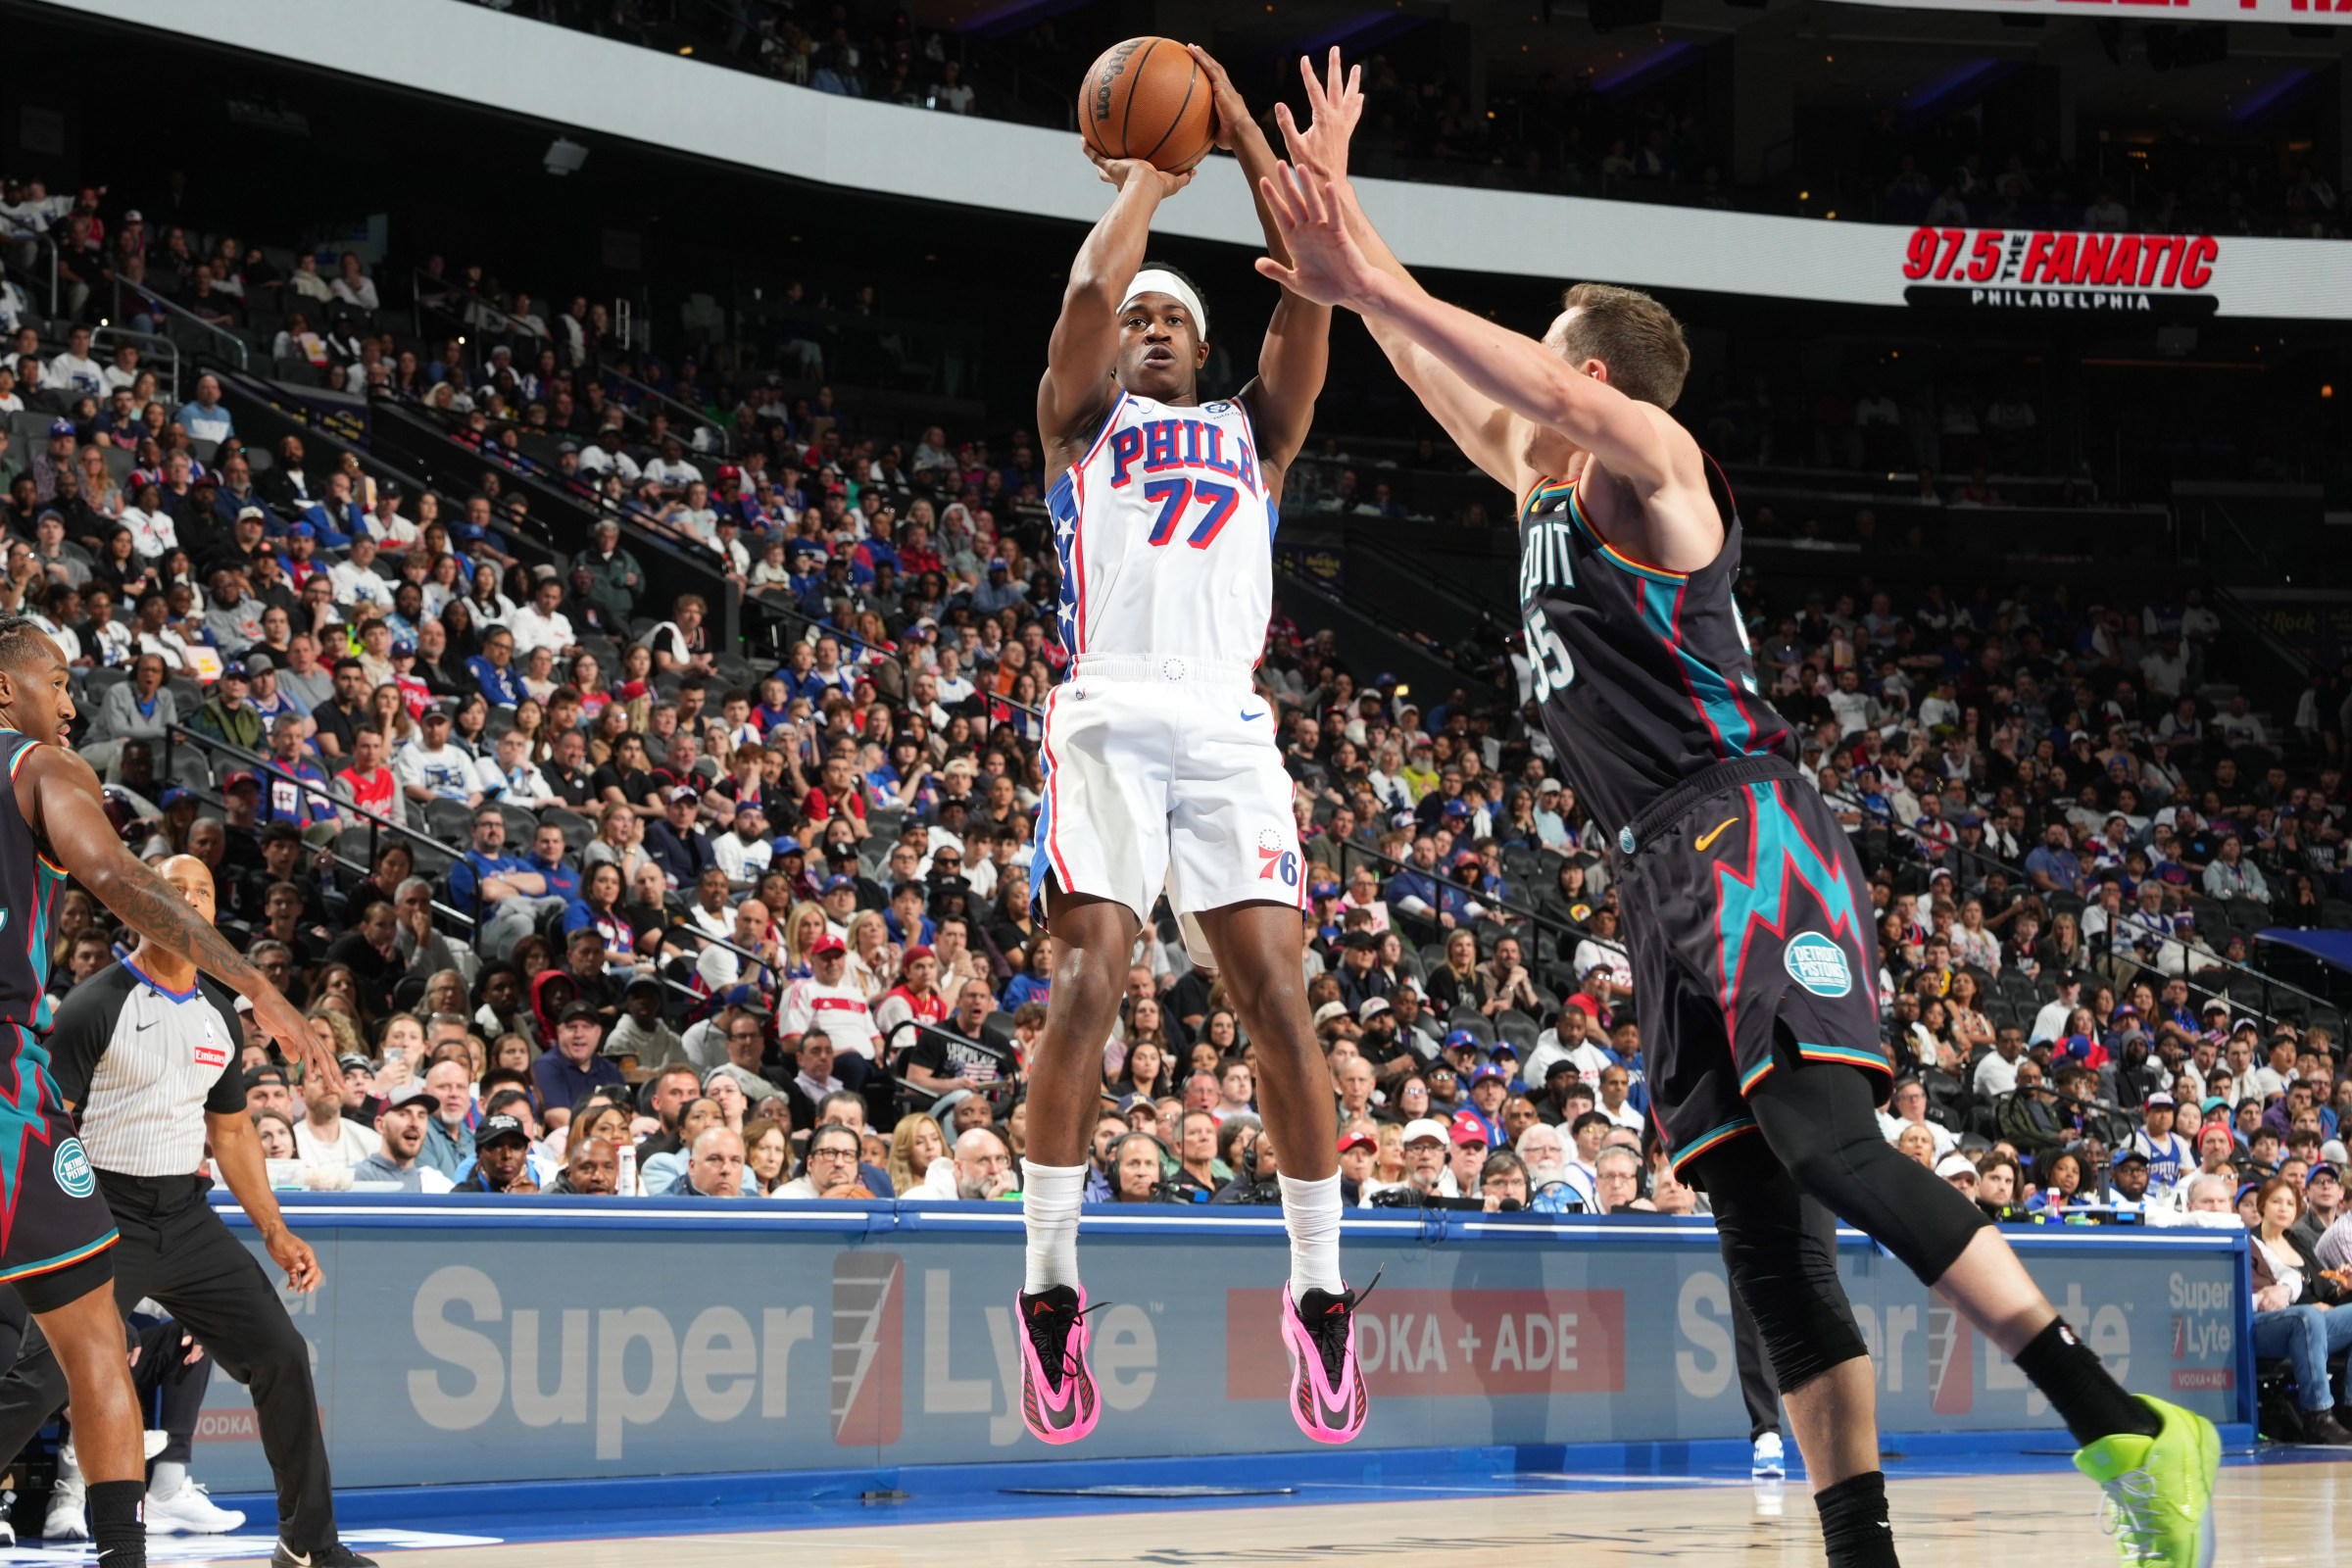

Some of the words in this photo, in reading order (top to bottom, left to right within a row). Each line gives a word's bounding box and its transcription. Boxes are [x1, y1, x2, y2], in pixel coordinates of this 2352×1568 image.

[1096, 38, 1148, 122] Wilson
[1902, 226, 2005, 281] 97.5
[2001, 233, 2026, 281] THE
[2020, 231, 2220, 289] FANATIC
[1971, 289, 2151, 312] PHILADELPHIA
[1110, 418, 1258, 502] PHILA
[1144, 477, 1240, 550] 77
[1257, 845, 1298, 887] 76
[1792, 946, 1839, 962] DETROIT
[1797, 960, 1845, 979] PISTONS
[64, 1154, 86, 1172] DETROIT
[66, 1163, 89, 1182] PISTONS
[2169, 1271, 2232, 1317] Super
[1279, 1313, 1448, 1374] DKA
[1492, 1313, 1578, 1372] ADE
[2186, 1315, 2230, 1360] Lyte
[407, 1264, 814, 1460] Super
[923, 1268, 1157, 1446] Lye
[2179, 1373, 2205, 1387] VODKA
